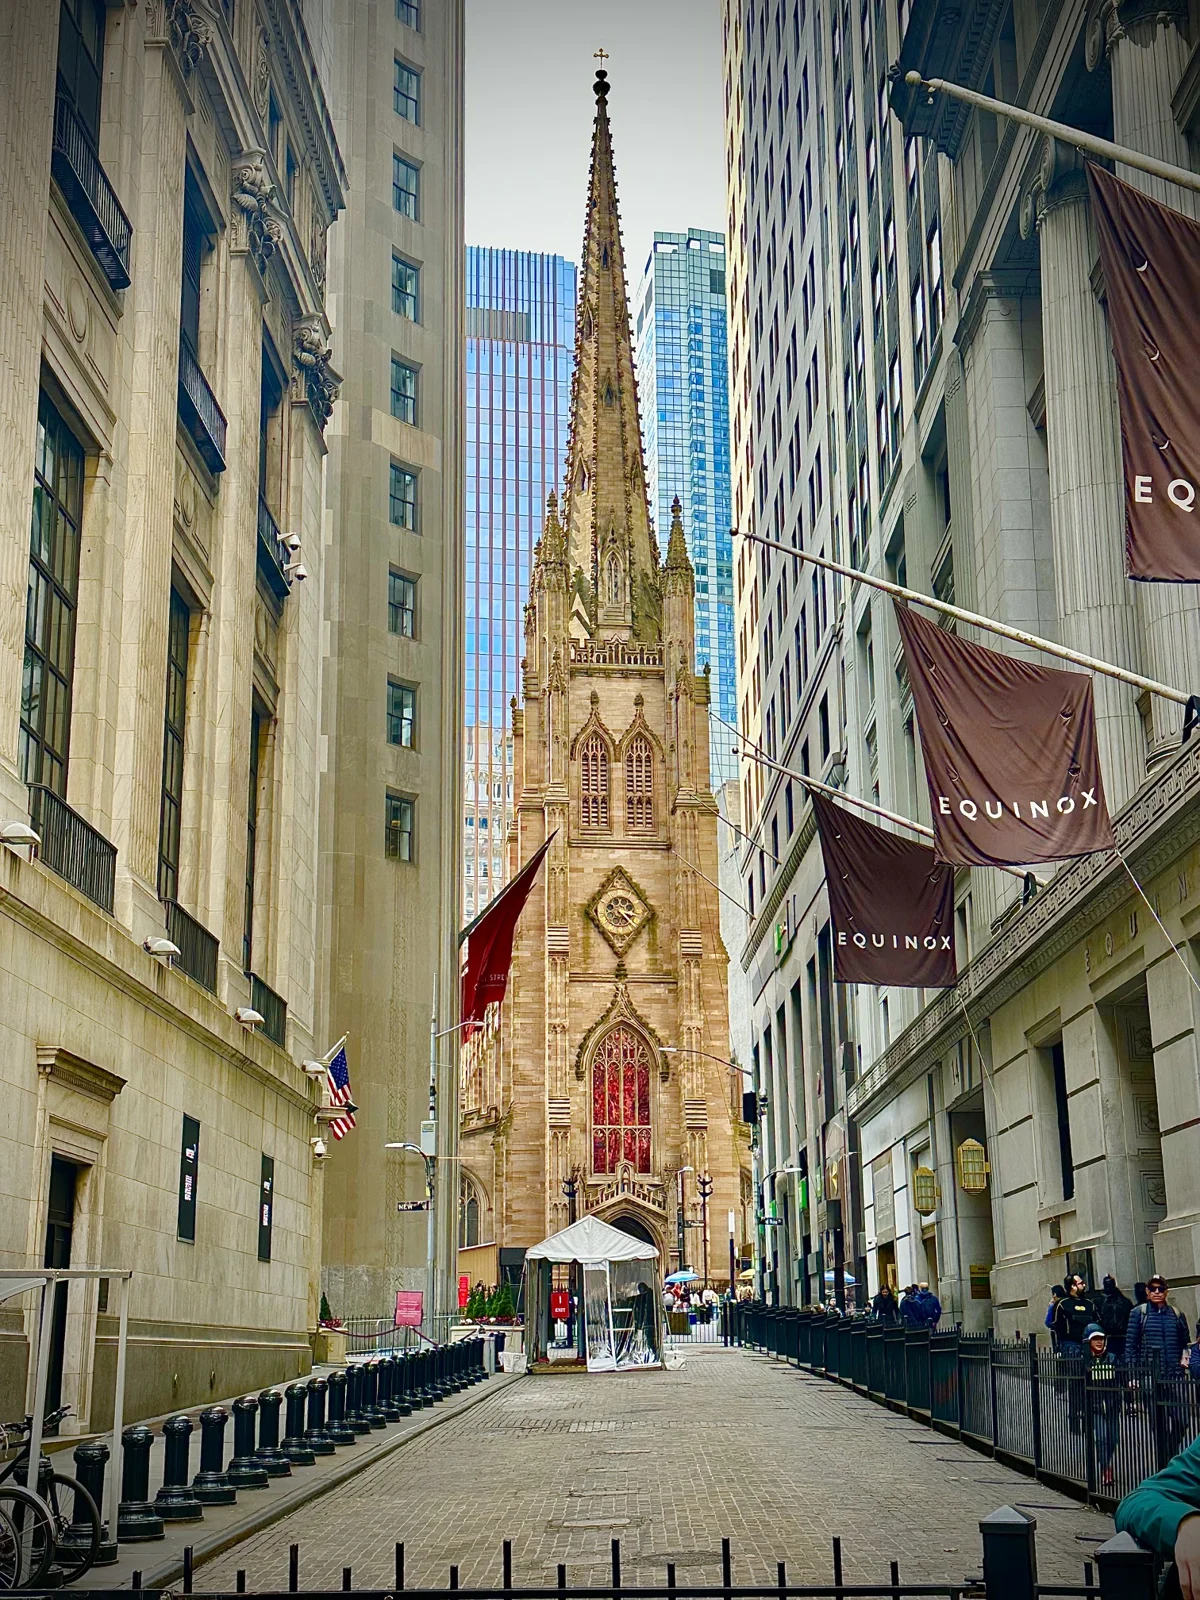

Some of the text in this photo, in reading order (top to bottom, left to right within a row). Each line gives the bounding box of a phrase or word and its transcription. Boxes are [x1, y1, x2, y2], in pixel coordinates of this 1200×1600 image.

[1135, 475, 1195, 513] EQ
[938, 787, 1098, 821] EQUINOX
[837, 932, 951, 950] EQUINOX
